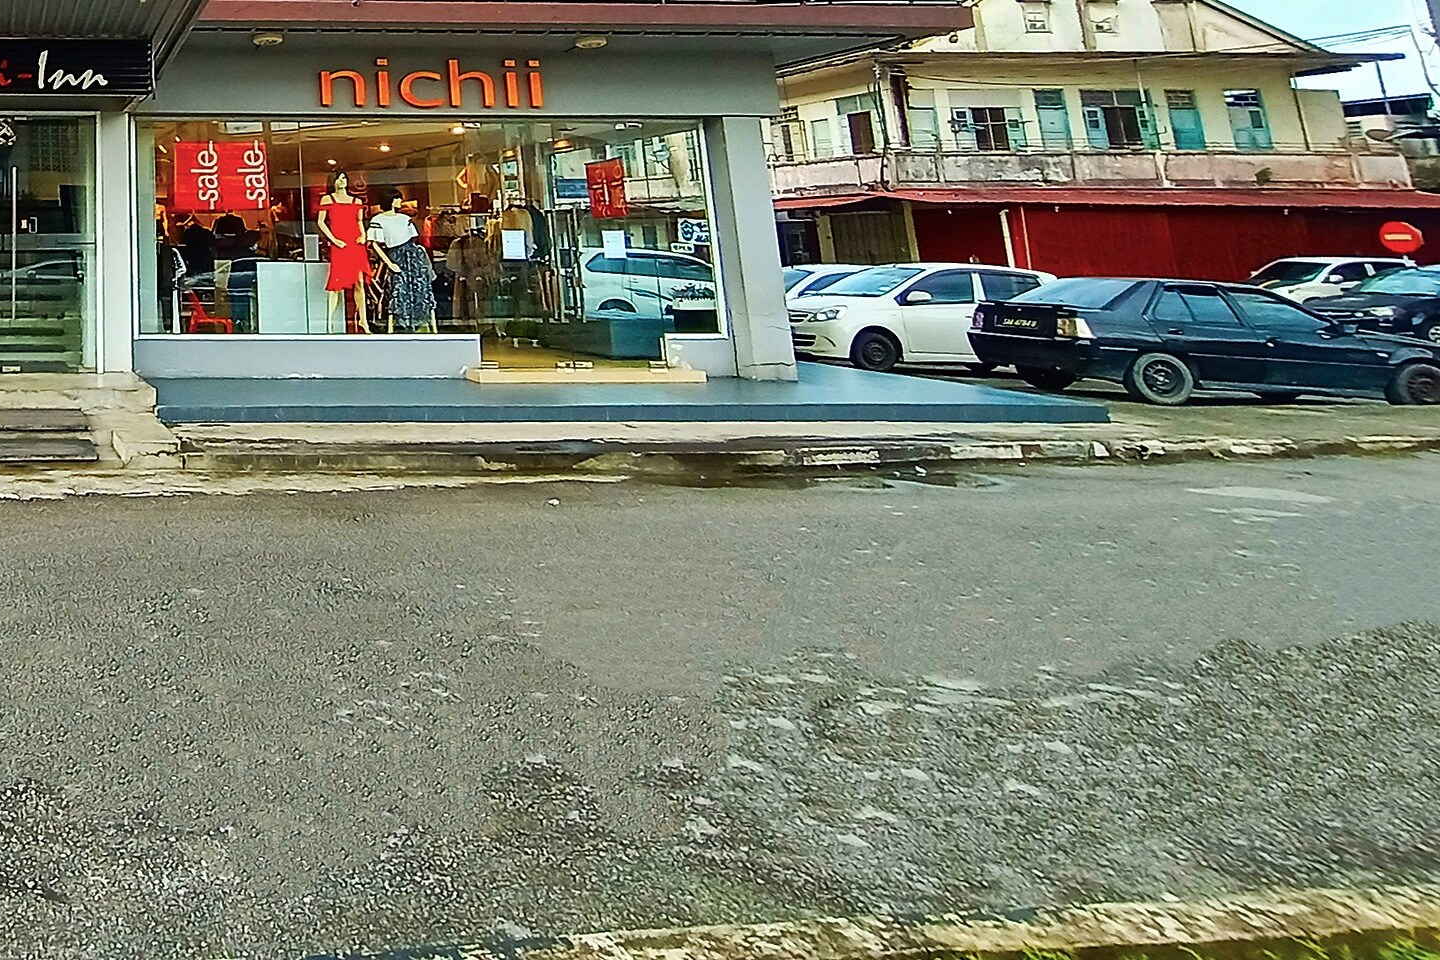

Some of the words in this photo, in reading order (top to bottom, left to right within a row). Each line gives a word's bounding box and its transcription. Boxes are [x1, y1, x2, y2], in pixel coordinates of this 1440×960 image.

[318, 57, 544, 109] nichii
[190, 141, 219, 209] sale
[237, 140, 266, 208] sale
